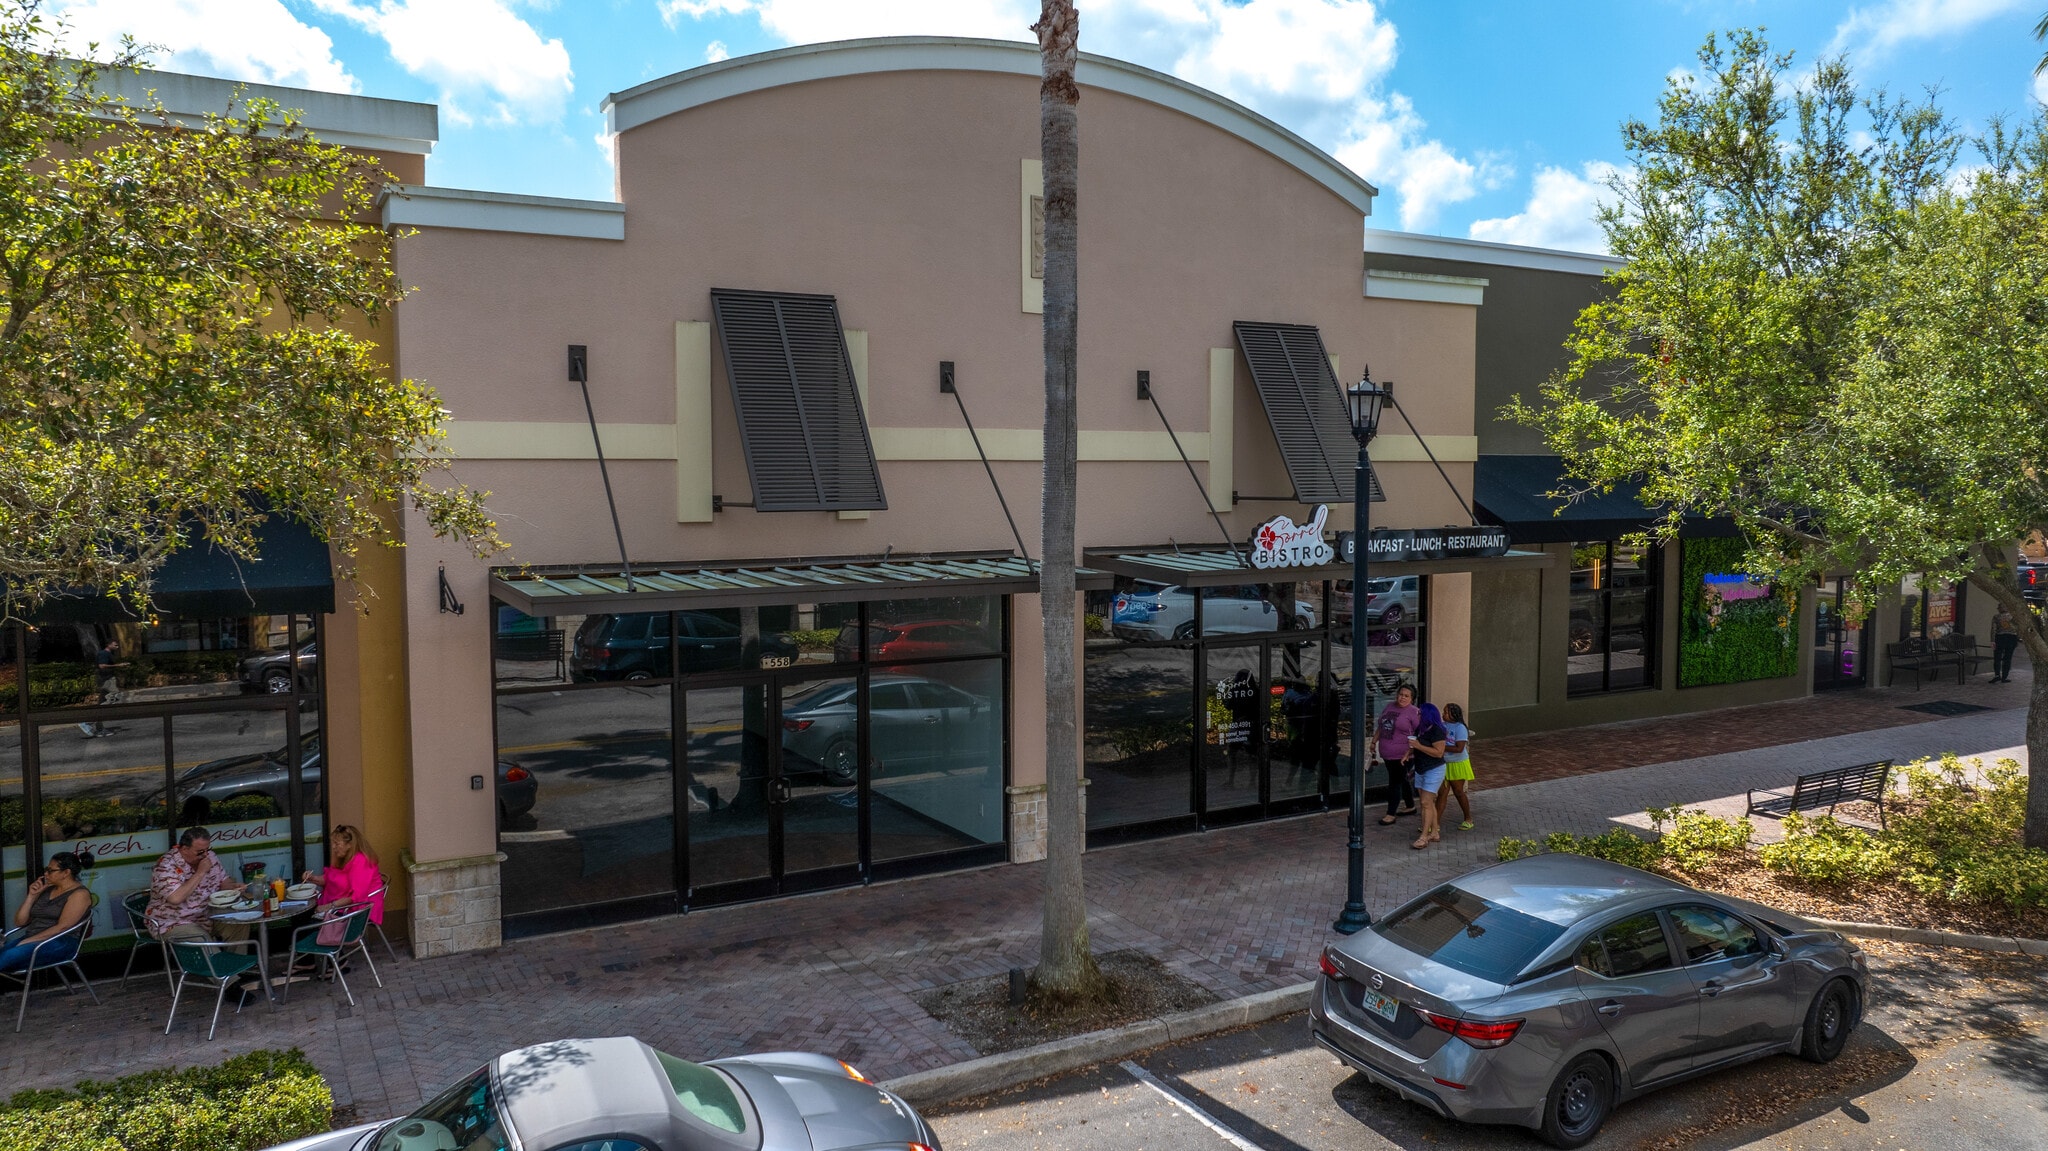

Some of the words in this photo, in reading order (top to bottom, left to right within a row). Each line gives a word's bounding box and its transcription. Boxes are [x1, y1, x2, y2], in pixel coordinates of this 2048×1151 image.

[1268, 508, 1326, 558] Sorrel
[1347, 539, 1404, 554] BAKFAST
[1411, 538, 1442, 551] LUNCH
[1448, 535, 1506, 550] RESTAURANT
[1260, 545, 1324, 563] BISTRO
[1929, 605, 1952, 618] AYCE
[770, 657, 789, 667] 558
[1216, 690, 1254, 700] BISTRO
[211, 820, 277, 842] asual.
